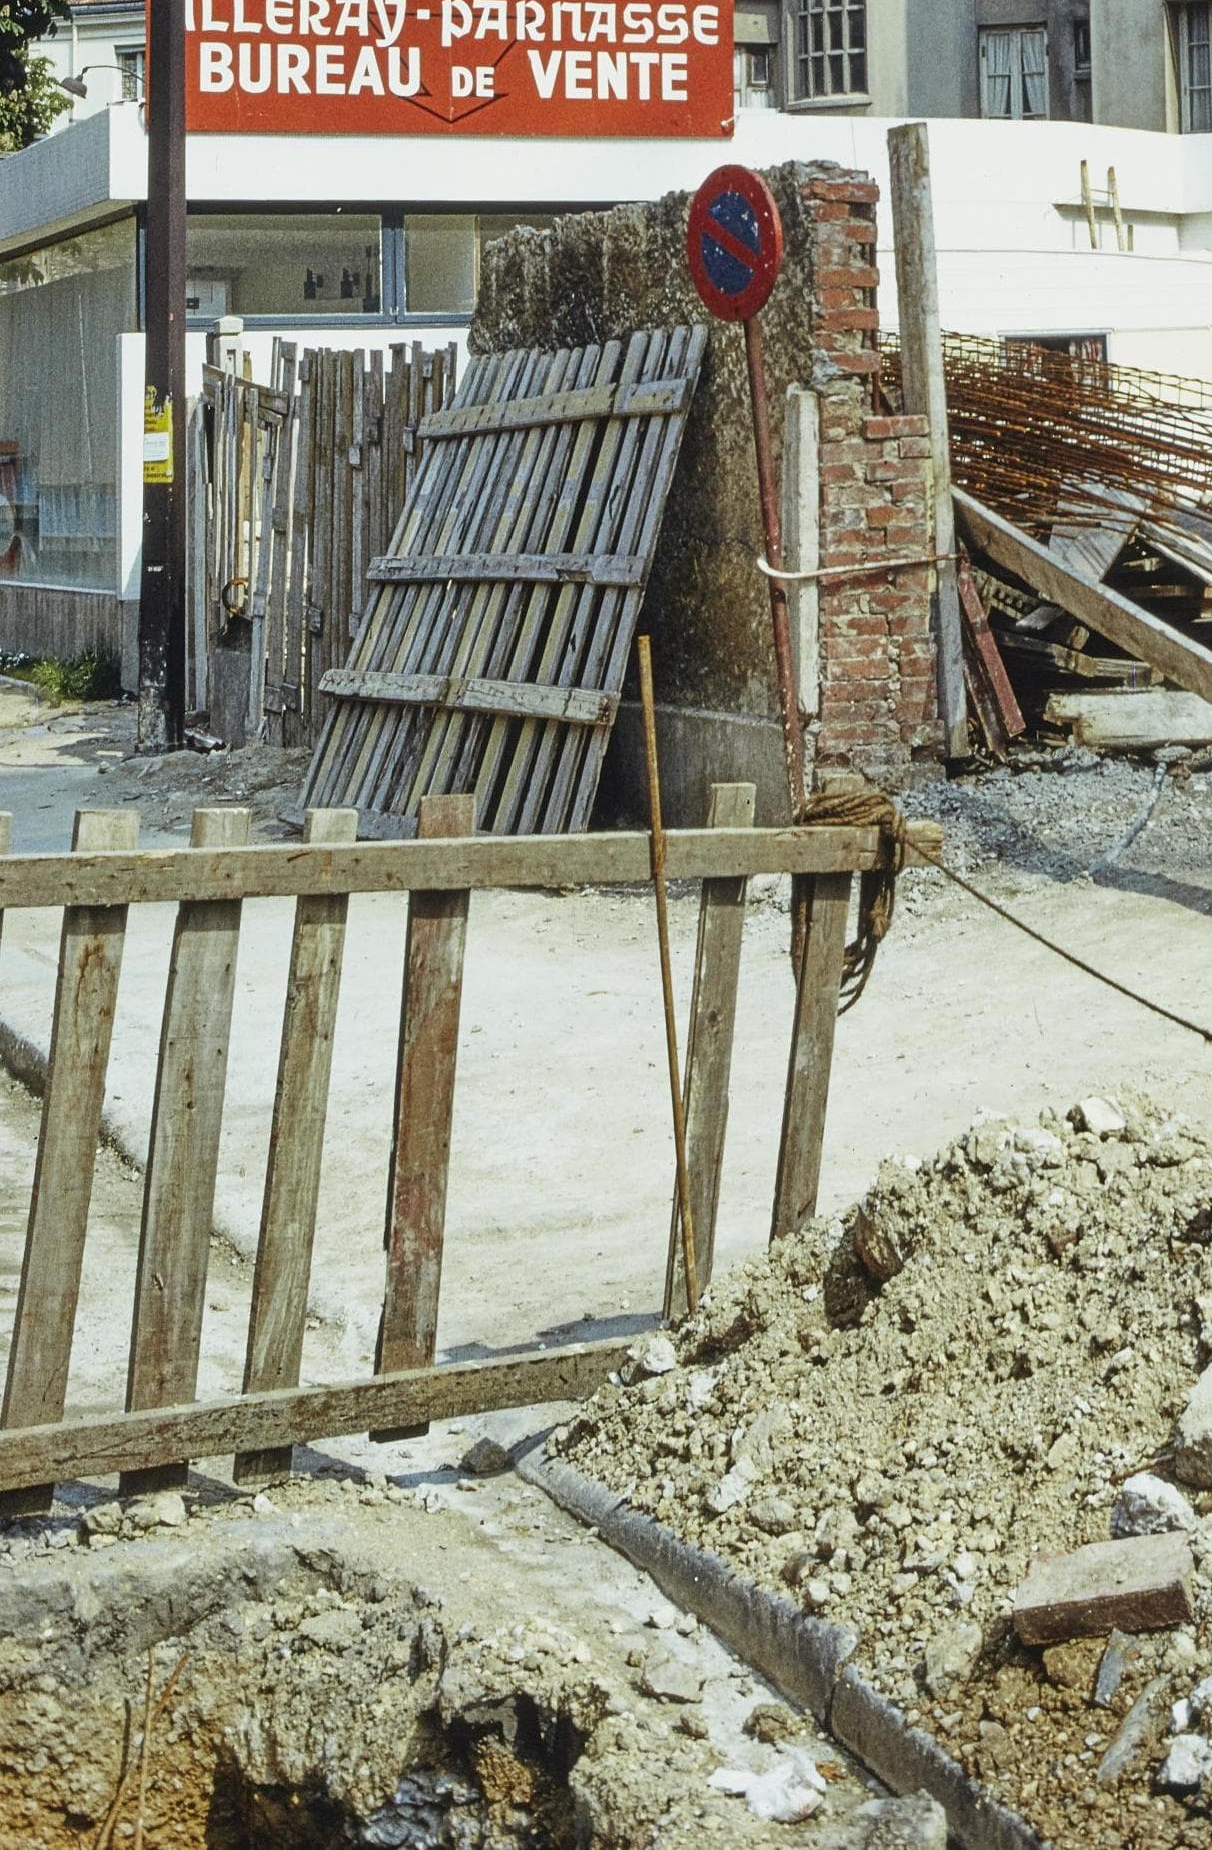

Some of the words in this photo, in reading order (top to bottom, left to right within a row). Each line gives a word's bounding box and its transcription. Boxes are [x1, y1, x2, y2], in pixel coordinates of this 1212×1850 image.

[199, 41, 421, 98] BUREAU
[451, 65, 495, 97] DE
[527, 50, 688, 101] VENTE
